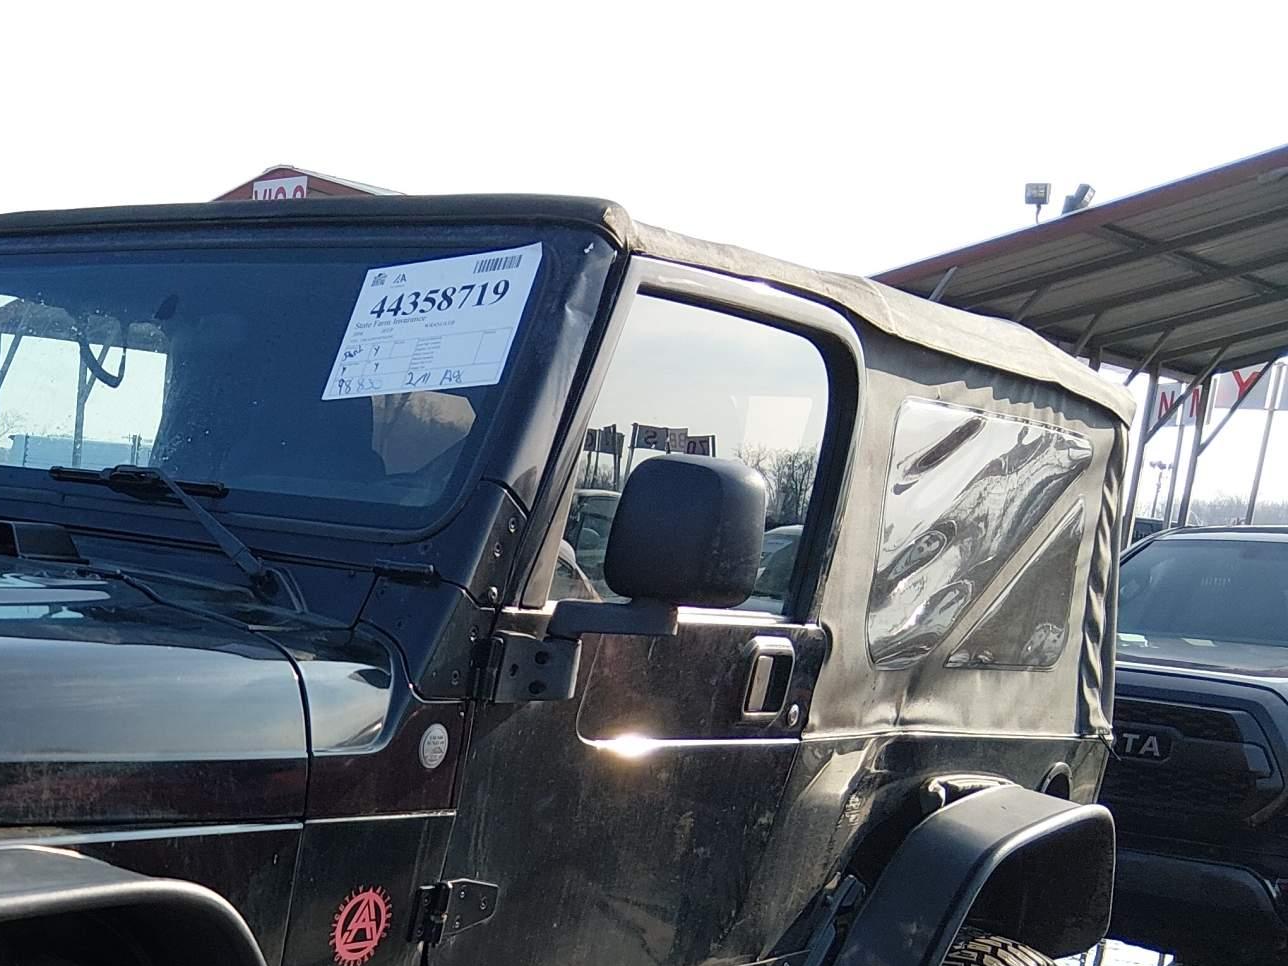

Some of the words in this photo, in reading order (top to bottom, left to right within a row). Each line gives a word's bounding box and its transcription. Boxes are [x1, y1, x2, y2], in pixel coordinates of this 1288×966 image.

[370, 279, 510, 319] 44358719
[355, 321, 371, 330] State
[373, 320, 392, 328] Farm
[393, 316, 427, 325] Insurance
[1232, 370, 1261, 400] Y
